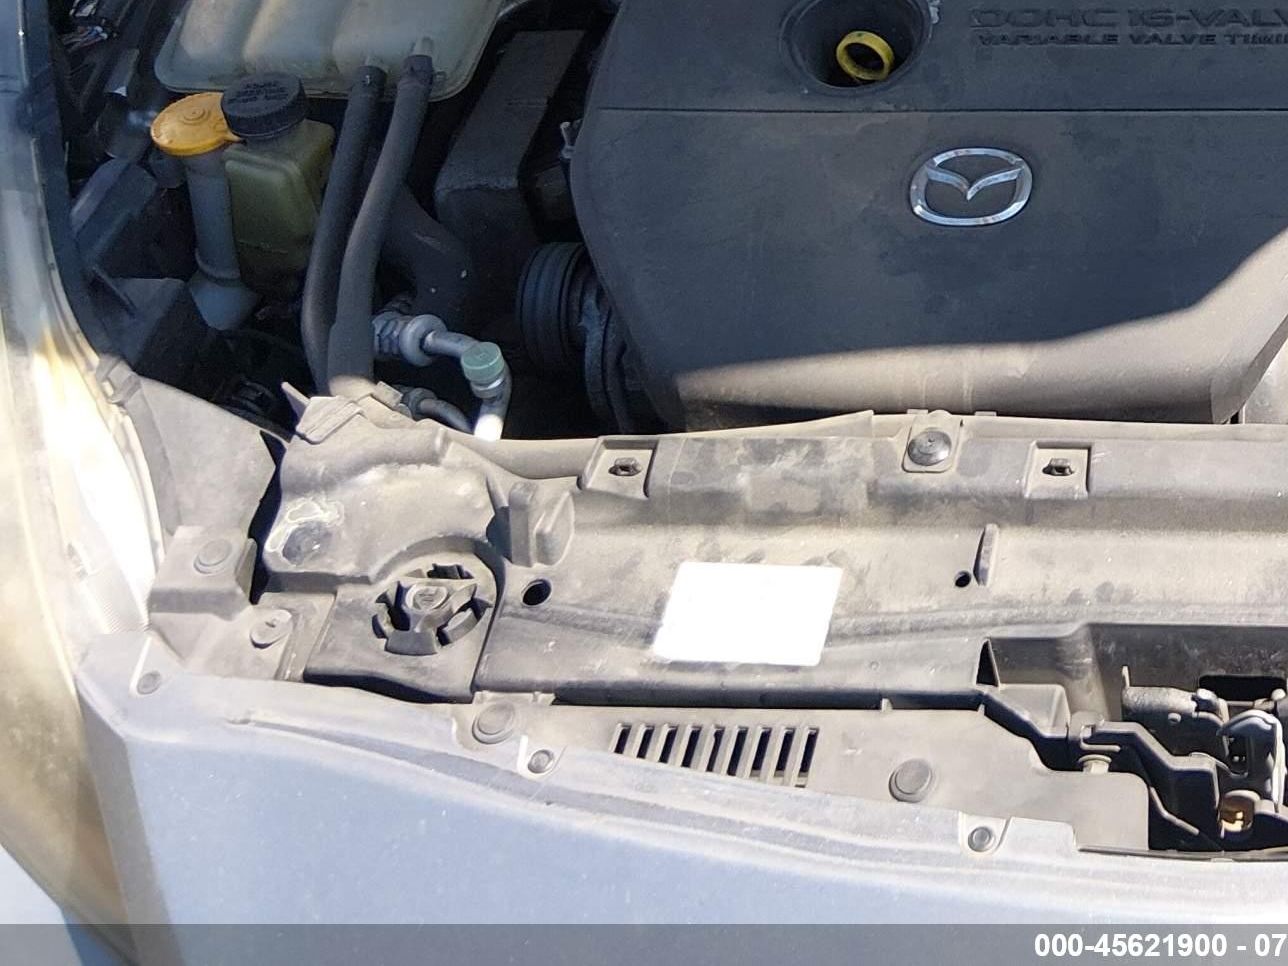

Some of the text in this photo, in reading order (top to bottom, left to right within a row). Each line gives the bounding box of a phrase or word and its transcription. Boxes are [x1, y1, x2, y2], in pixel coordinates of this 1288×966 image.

[969, 9, 1119, 28] DOHC
[978, 33, 1119, 46] VARIABLE
[1129, 33, 1217, 46] VALVE
